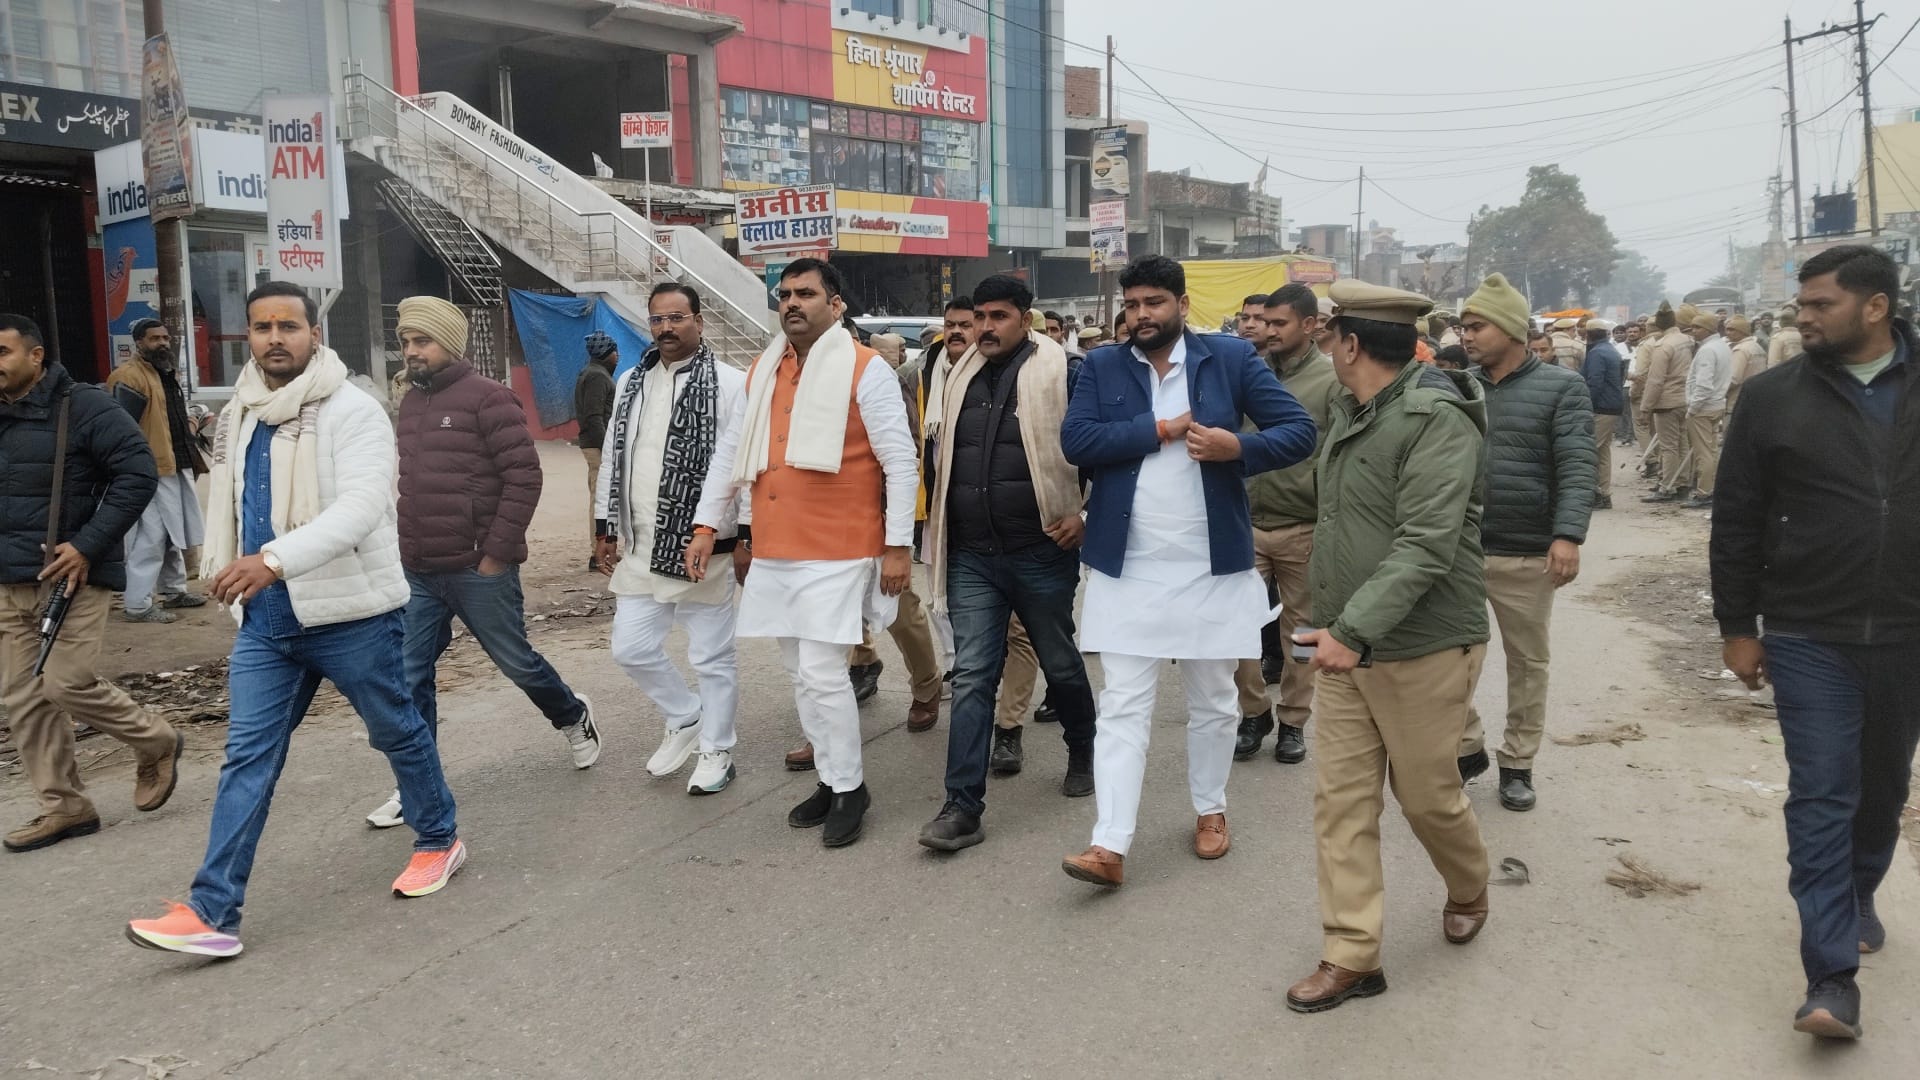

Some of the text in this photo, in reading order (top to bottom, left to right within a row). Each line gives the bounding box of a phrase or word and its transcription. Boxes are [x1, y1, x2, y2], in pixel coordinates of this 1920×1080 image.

[0, 92, 42, 123] EX
[451, 104, 525, 160] BOMBAY FASHION
[272, 146, 324, 179] ATM
[108, 181, 147, 216] india
[740, 189, 830, 219] अनीस
[789, 216, 834, 238] हाउस
[278, 244, 324, 272] एटीएम
